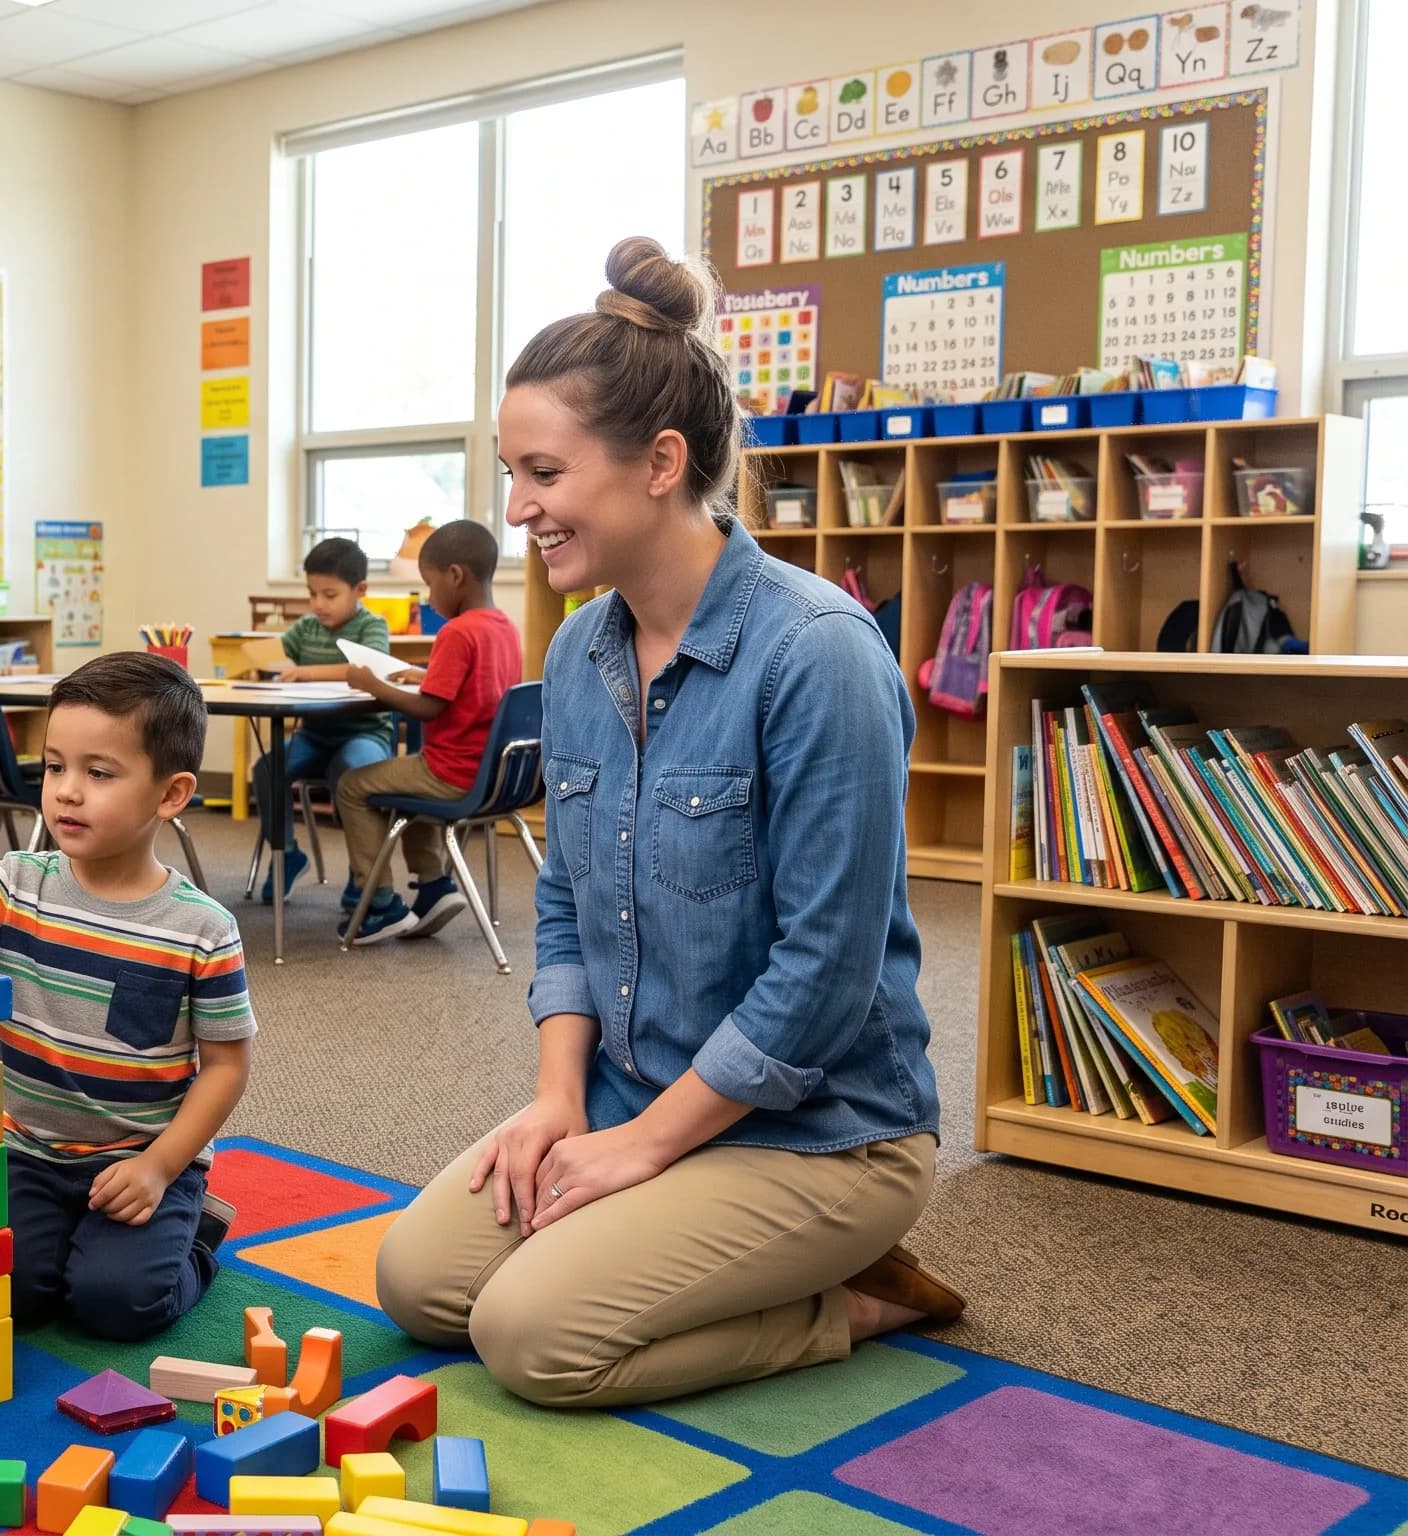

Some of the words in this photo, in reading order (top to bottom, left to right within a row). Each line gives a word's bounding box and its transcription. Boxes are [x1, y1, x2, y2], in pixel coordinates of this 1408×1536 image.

[1245, 38, 1279, 63] Zz
[1175, 51, 1206, 74] Yn
[1105, 62, 1145, 90] Qq
[982, 84, 1017, 107] Gh
[1051, 73, 1070, 102] Ij
[933, 91, 957, 115] Ff
[836, 109, 867, 133] Dd
[884, 102, 910, 125] Ee
[749, 128, 774, 148] Bb
[793, 119, 820, 140] Cc
[699, 138, 727, 156] Aa
[1113, 141, 1126, 161] 8
[1173, 131, 1195, 153] 10
[995, 160, 1008, 179] 6
[1052, 150, 1066, 170] 7
[888, 176, 900, 194] 4
[940, 168, 953, 187] 5
[795, 190, 806, 208] 2
[841, 184, 852, 202] 3
[1119, 243, 1225, 269] Numbers
[897, 269, 989, 294] Numbers
[1167, 272, 1175, 284] 3
[1187, 270, 1195, 280] 4
[1207, 269, 1215, 280] 5
[1226, 267, 1235, 278] 6
[948, 297, 955, 309] 2
[967, 296, 975, 307] 3
[986, 293, 994, 304] 4
[1204, 288, 1215, 300] 11
[1223, 287, 1236, 298] 12
[1202, 308, 1215, 319] 17
[891, 324, 898, 335] 6
[929, 320, 935, 331] 8
[948, 318, 954, 329] 9
[964, 316, 977, 328] 10
[984, 314, 995, 326] 11
[906, 341, 918, 352] 14
[925, 340, 937, 352] 15
[944, 339, 956, 350] 16
[963, 336, 976, 348] 17
[1142, 333, 1157, 344] 22
[1161, 331, 1176, 343] 23
[1181, 330, 1196, 341] 24
[1200, 328, 1216, 340] 25
[887, 364, 900, 375] 20
[905, 362, 917, 374] 21
[923, 361, 937, 372] 22
[942, 359, 956, 371] 23
[961, 358, 976, 369] 24
